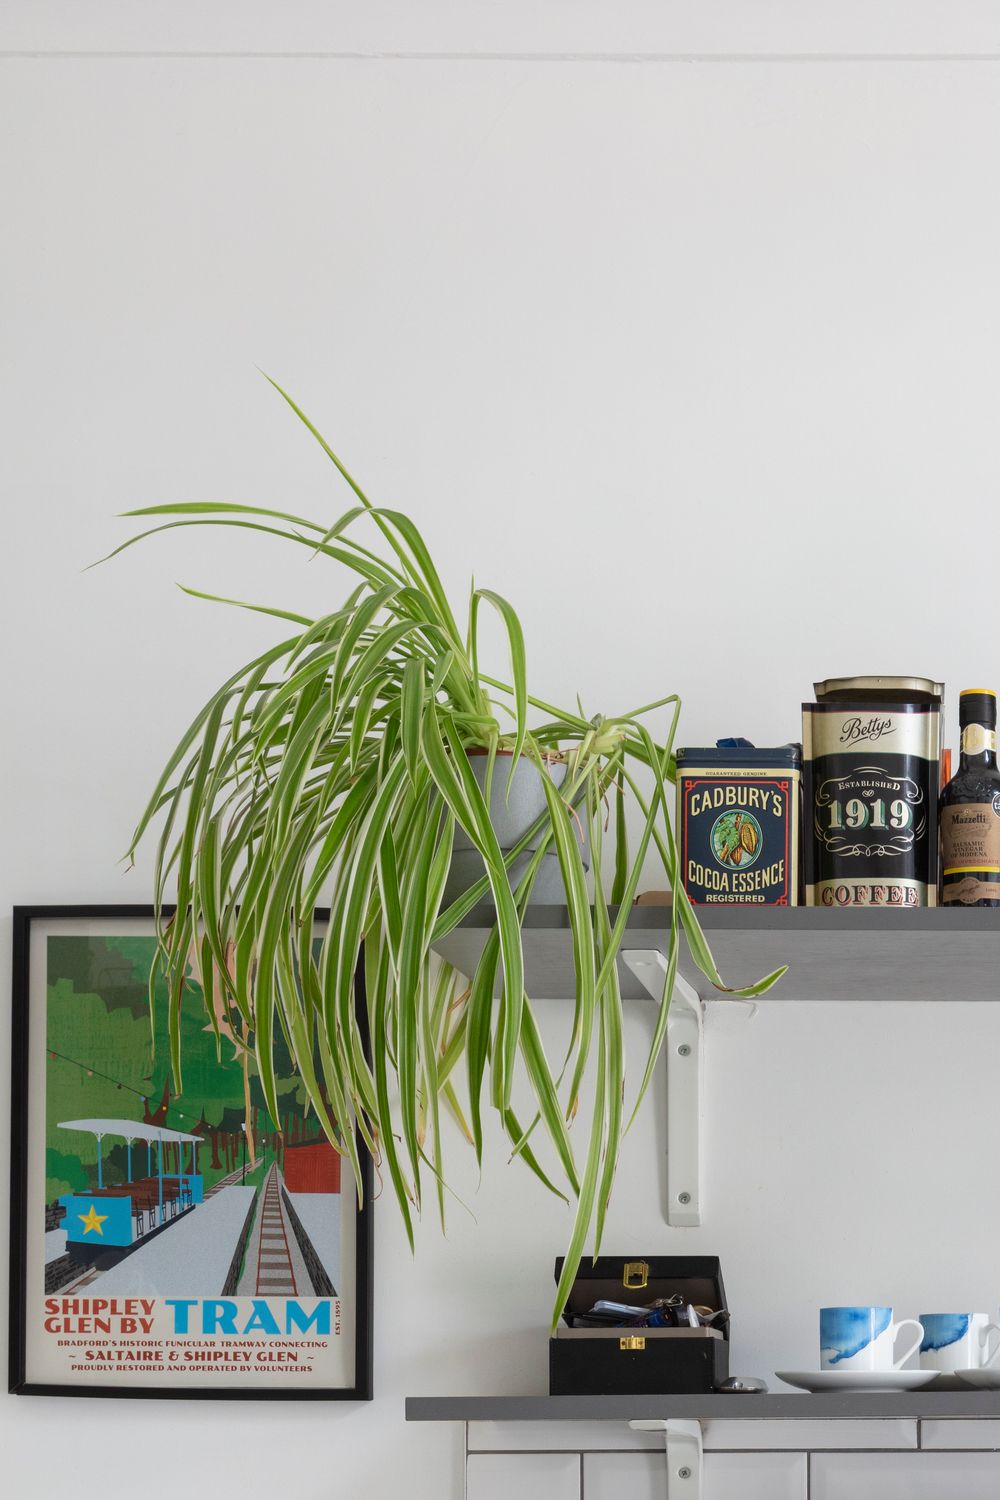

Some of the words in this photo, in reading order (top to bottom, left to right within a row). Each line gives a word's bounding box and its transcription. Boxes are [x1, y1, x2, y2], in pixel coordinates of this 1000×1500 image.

[839, 717, 896, 745] Bettys
[837, 780, 901, 792] ESTABLISHED
[690, 786, 783, 817] CADBURY'S
[827, 798, 913, 831] 1919
[951, 813, 986, 825] Mazzetti
[688, 860, 730, 892] COCOA
[732, 859, 785, 892] ESSENCE
[706, 894, 765, 903] REGISTERED
[821, 885, 919, 907] COFFEE
[44, 1298, 156, 1316] SHIPLEY
[164, 1299, 331, 1335] TRAM
[44, 1317, 111, 1334] GLEN
[120, 1317, 155, 1334] BY
[85, 1350, 163, 1361] SALTAIRE
[168, 1351, 179, 1361] &
[183, 1351, 253, 1362] SHIPLEY
[256, 1352, 298, 1362] GLEN
